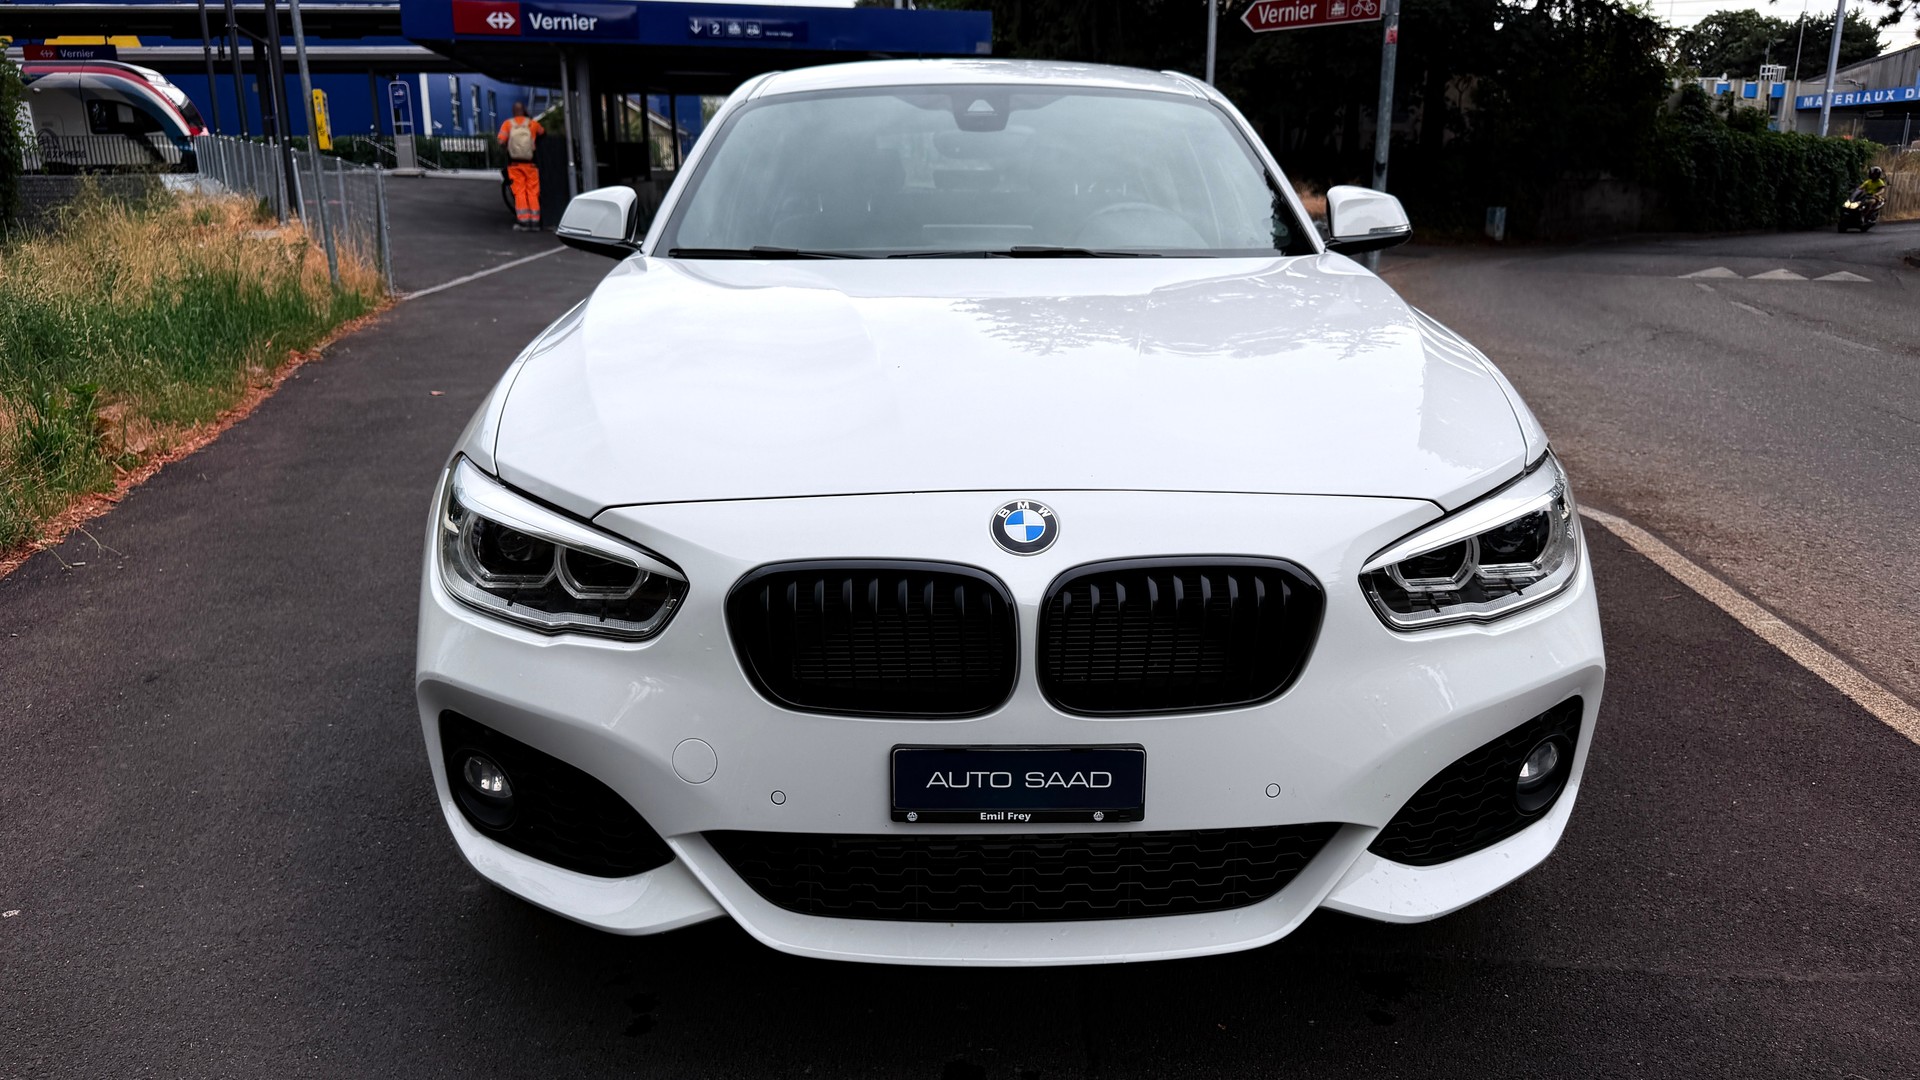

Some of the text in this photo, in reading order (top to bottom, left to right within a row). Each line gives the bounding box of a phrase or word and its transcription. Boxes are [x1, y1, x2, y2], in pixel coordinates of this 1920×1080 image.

[1258, 1, 1317, 24] Vernier
[528, 12, 598, 31] Vernier
[712, 23, 720, 35] 2
[60, 49, 94, 59] Vernier
[1803, 88, 1920, 107] MAERIAUX D
[997, 501, 1052, 518] BMW
[925, 771, 1112, 788] AUTO SAAD
[980, 811, 1031, 823] Emil Frey
